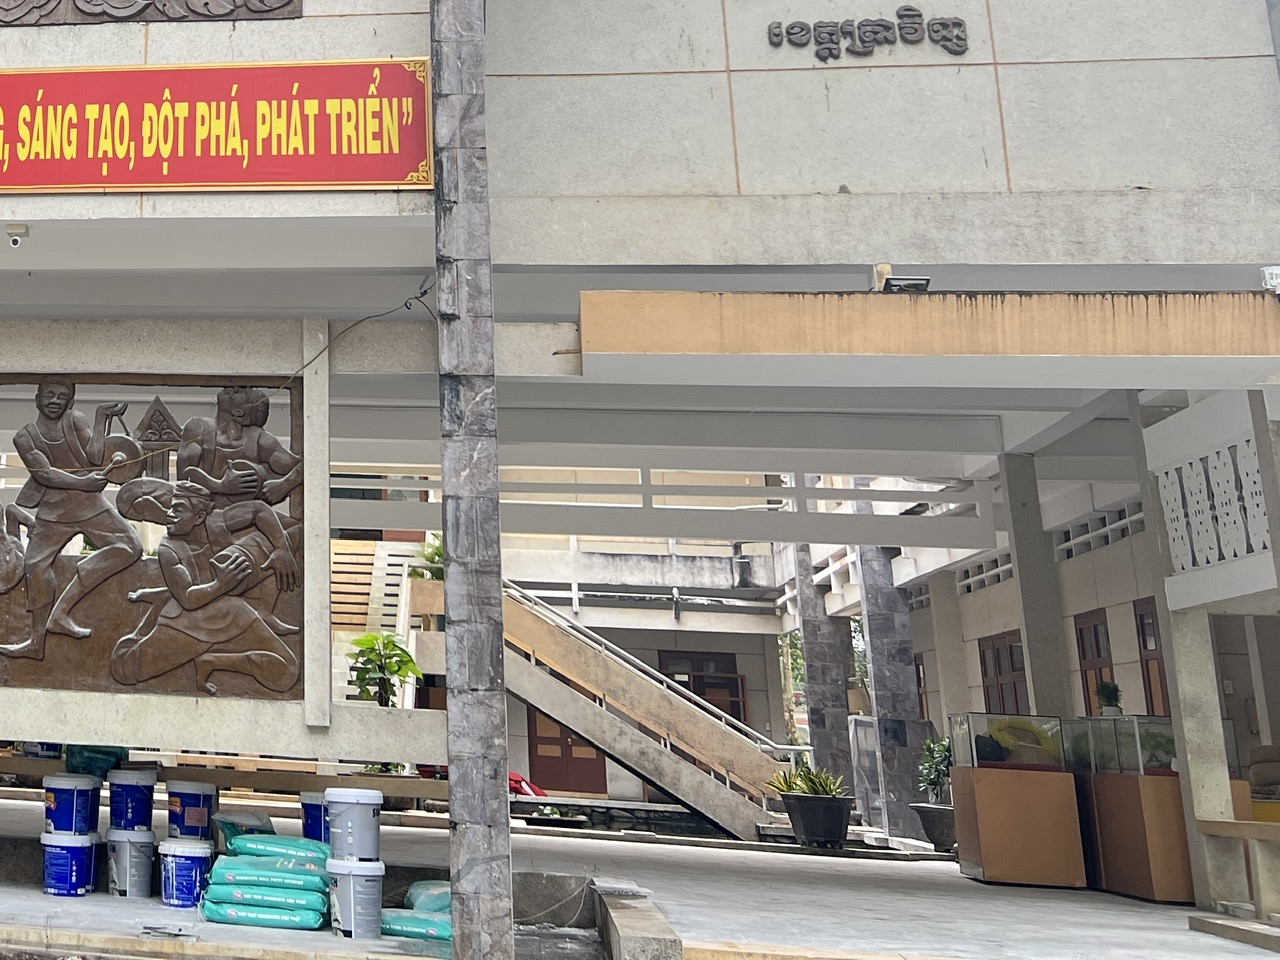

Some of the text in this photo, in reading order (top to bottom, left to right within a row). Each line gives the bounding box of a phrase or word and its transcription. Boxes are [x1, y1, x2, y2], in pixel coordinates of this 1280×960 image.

[17, 89, 78, 161] SÁNG
[85, 102, 136, 176] TẠO,
[142, 88, 189, 175] ĐỘT
[195, 84, 249, 169] PHÁ,
[256, 83, 319, 156] PHÁT
